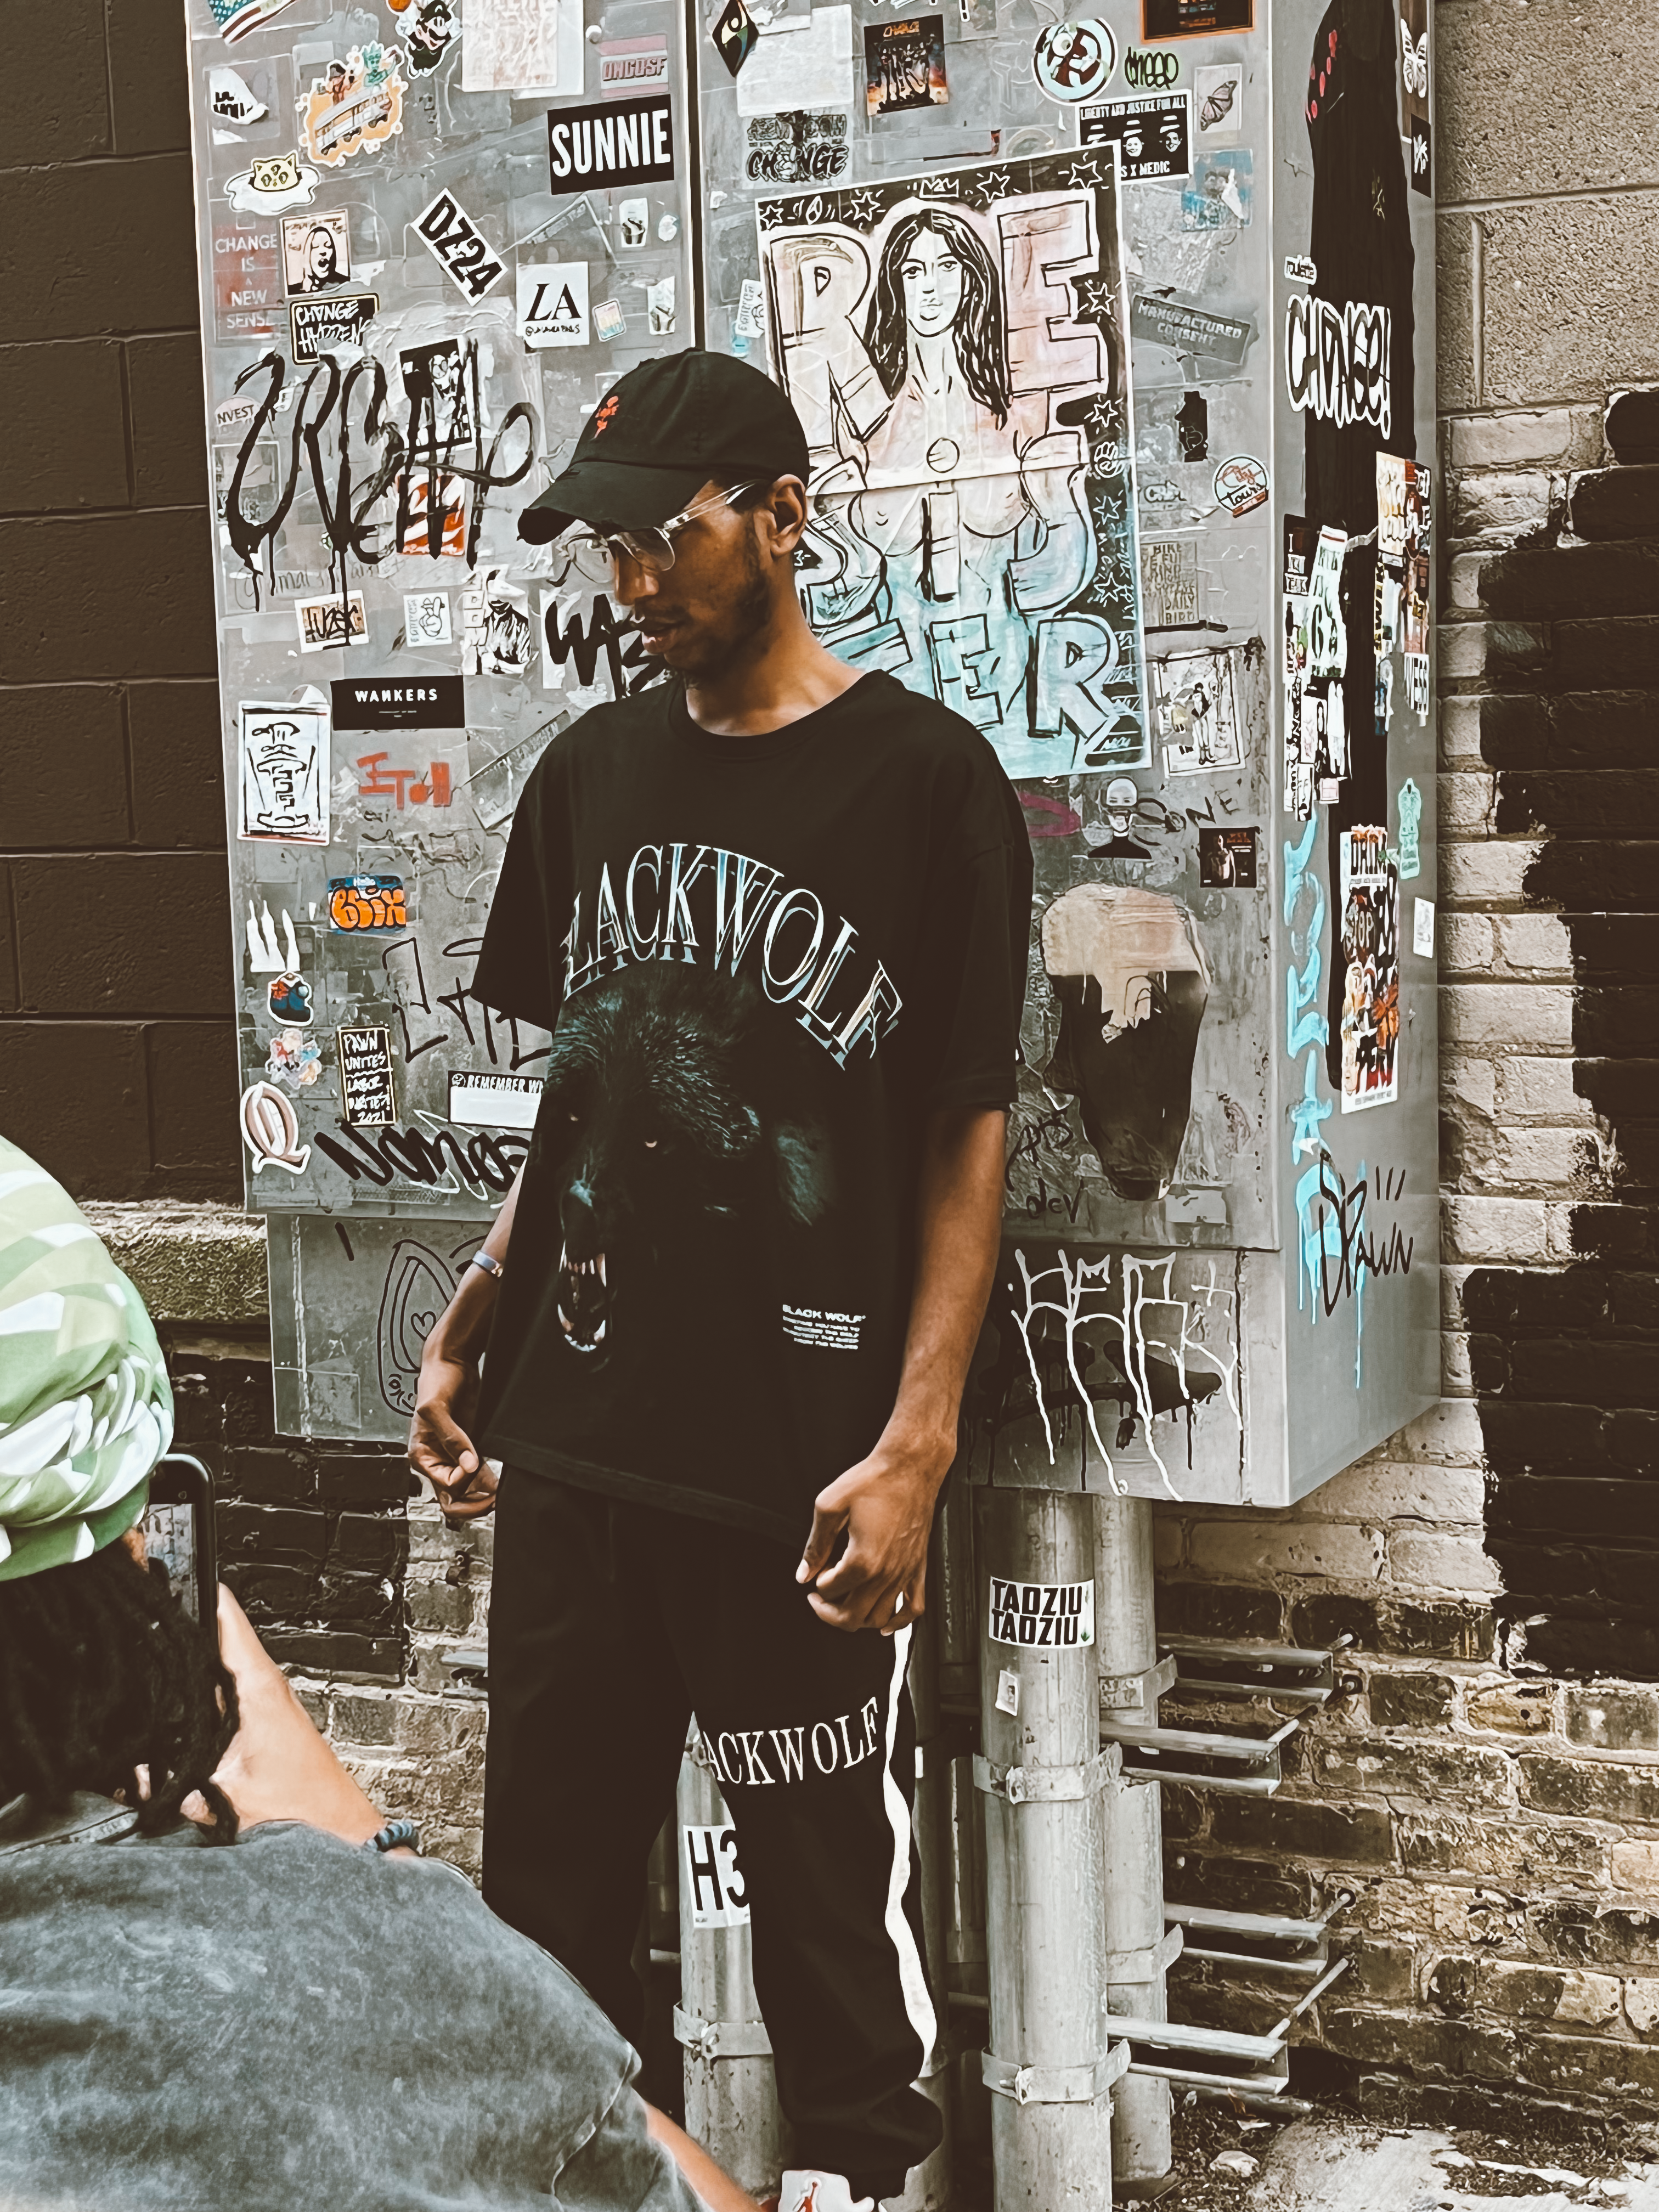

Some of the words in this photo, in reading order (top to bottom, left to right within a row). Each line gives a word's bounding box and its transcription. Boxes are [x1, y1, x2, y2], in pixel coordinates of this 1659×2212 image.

[1172, 95, 1186, 109] ALL
[551, 109, 670, 177] SUNNIE
[1139, 160, 1170, 176] MEDIC
[215, 233, 277, 253] CHANGE
[419, 194, 503, 298] DZ24
[241, 256, 255, 272] IS
[231, 289, 267, 307] NEW
[523, 283, 582, 321] LA
[296, 300, 359, 326] CHANGE
[1138, 300, 1242, 338] MANUFACTURED
[1157, 323, 1217, 346] CONSENT
[354, 689, 438, 703] WANKERS
[467, 1074, 526, 1093] REMEMBER
